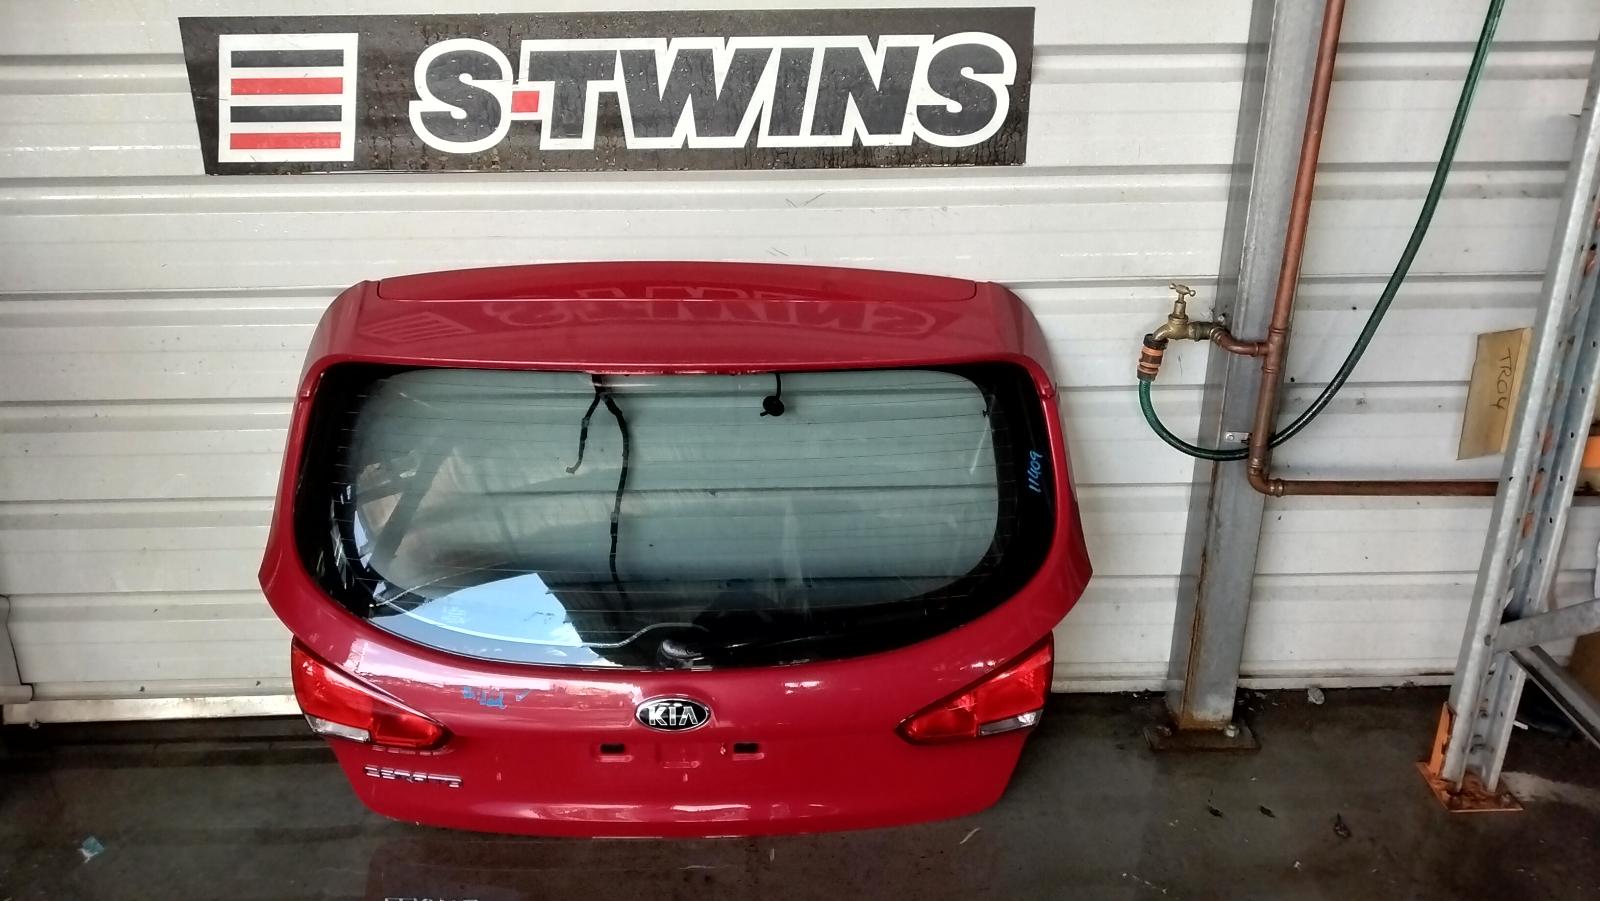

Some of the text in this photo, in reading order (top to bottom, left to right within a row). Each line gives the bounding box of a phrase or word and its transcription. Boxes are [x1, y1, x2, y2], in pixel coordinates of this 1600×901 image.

[1489, 347, 1513, 410] TROY
[1028, 450, 1043, 493] 11409
[647, 704, 699, 726] KIA
